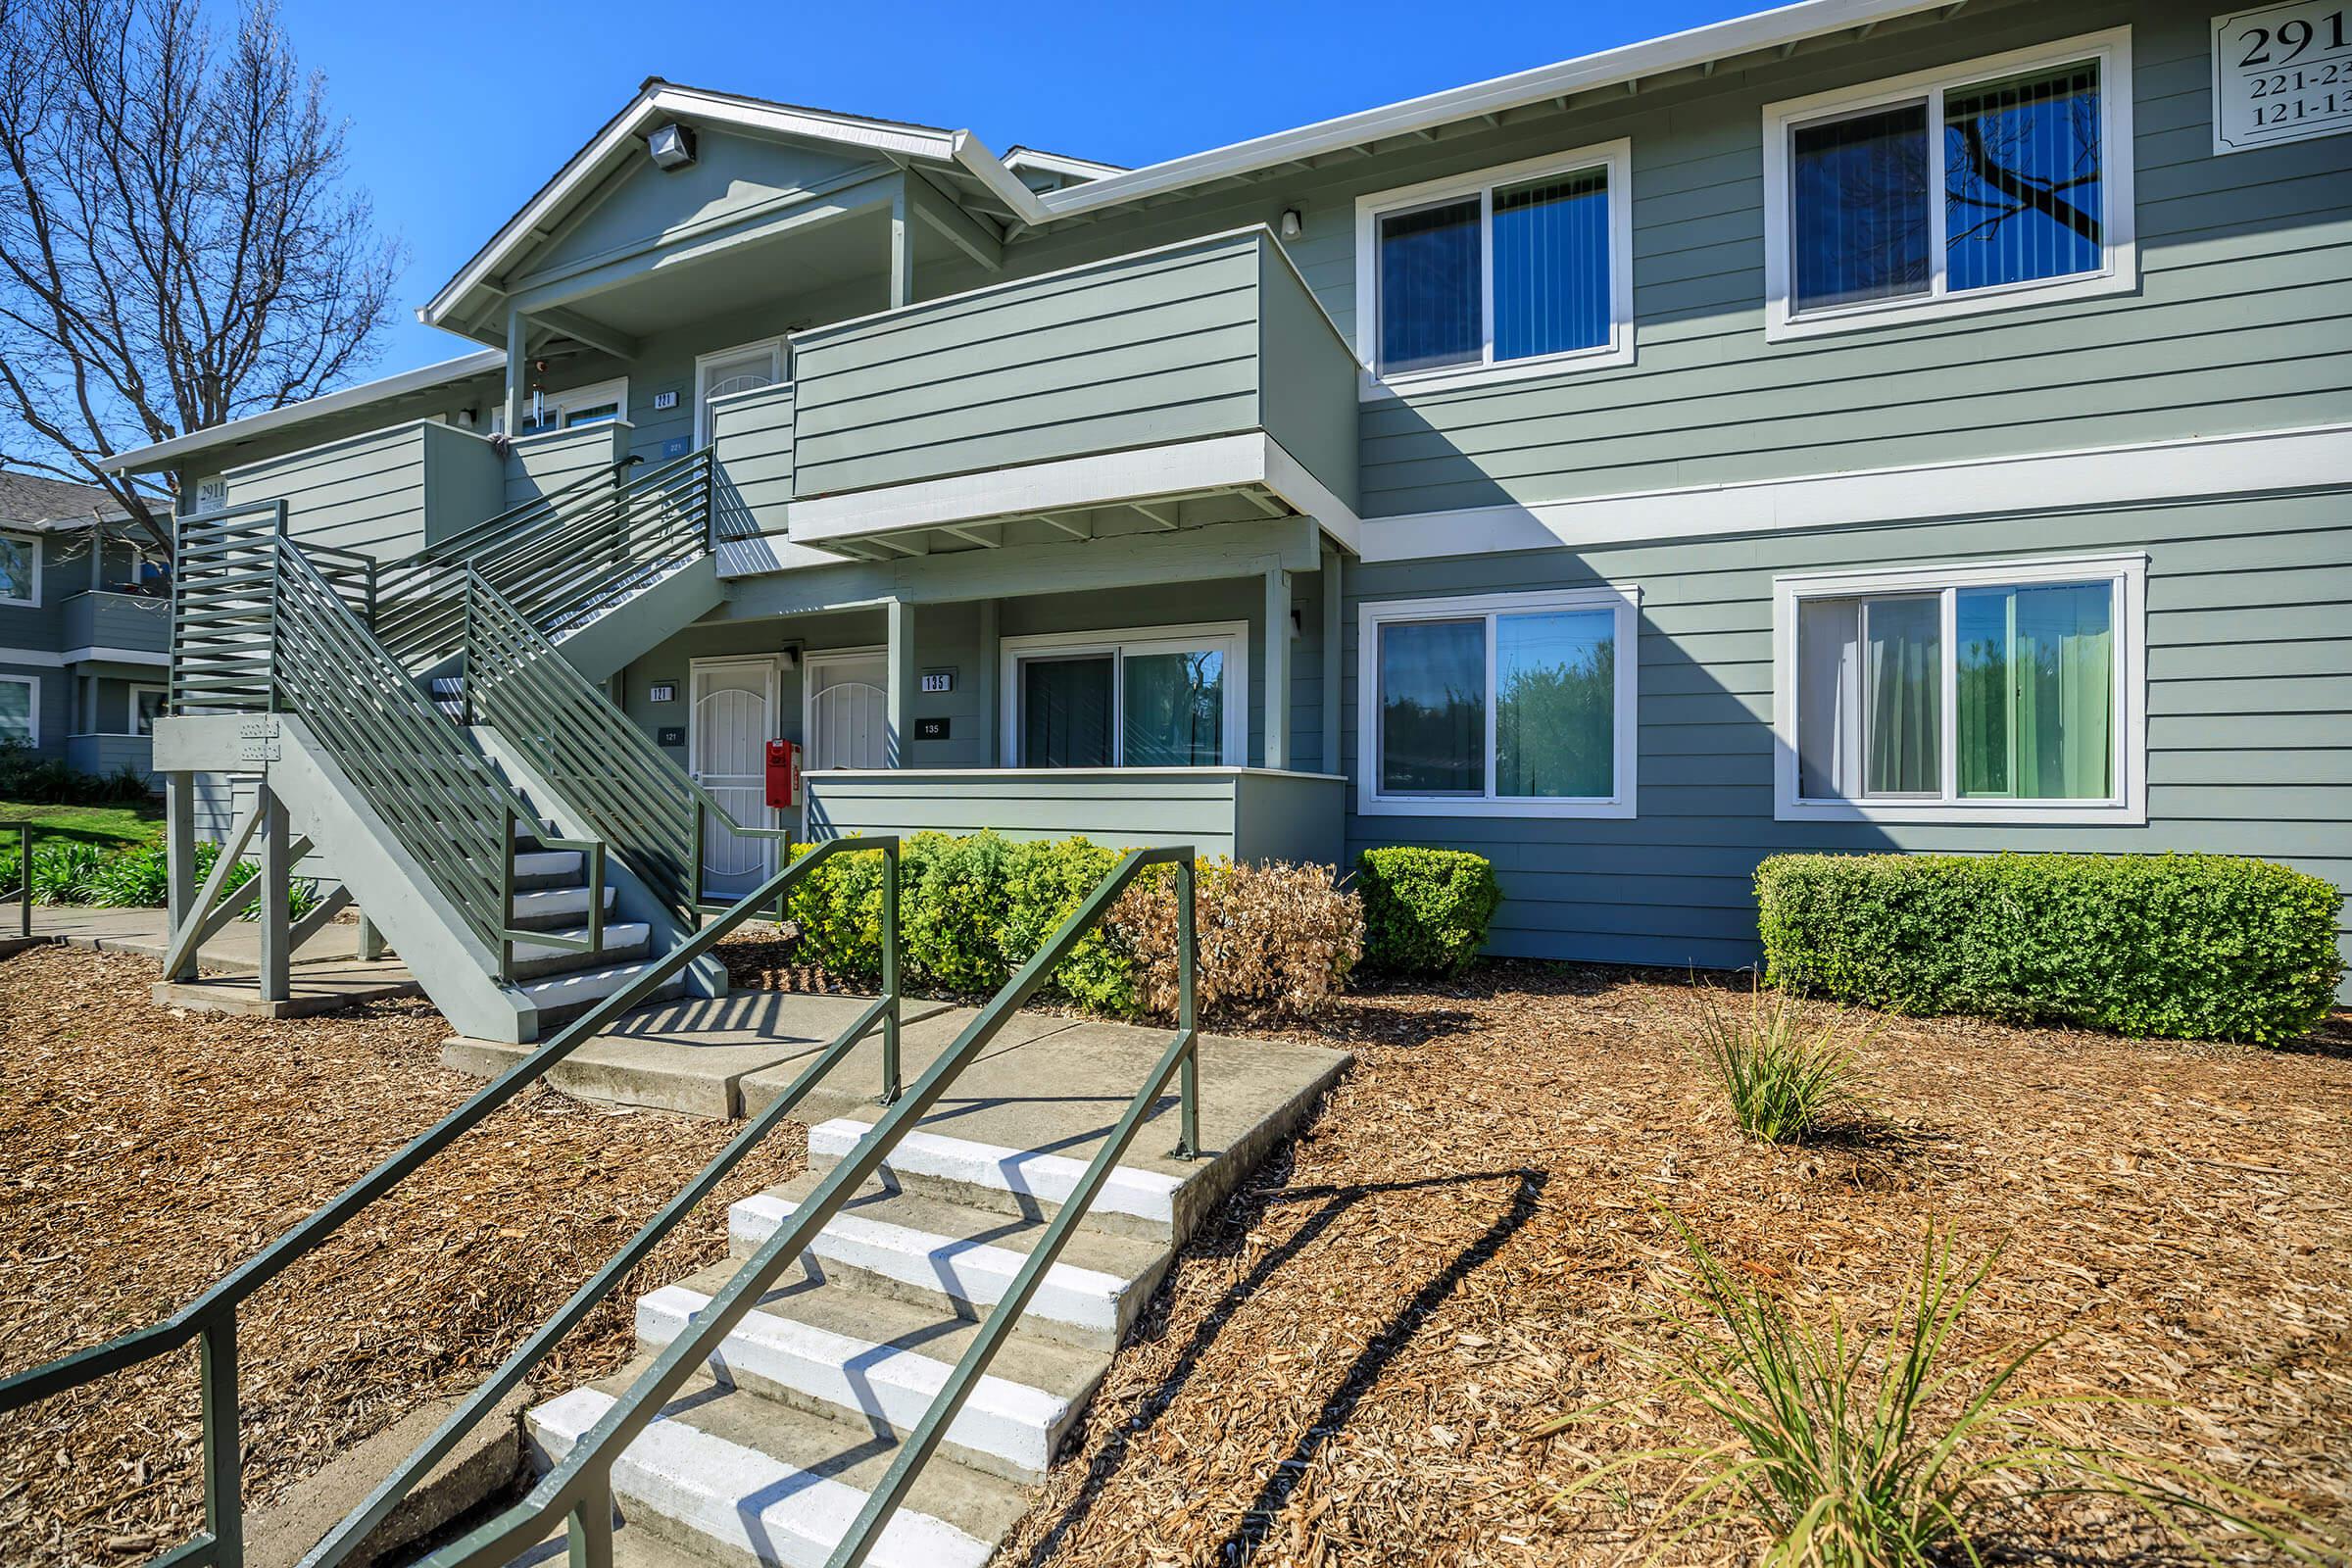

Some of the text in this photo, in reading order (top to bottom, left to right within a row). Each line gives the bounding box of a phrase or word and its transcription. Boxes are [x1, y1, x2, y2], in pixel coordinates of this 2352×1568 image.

[658, 393, 670, 407] 221
[201, 482, 224, 501] 2911
[926, 675, 944, 690] 135
[654, 688, 666, 700] 121
[925, 724, 939, 734] 135
